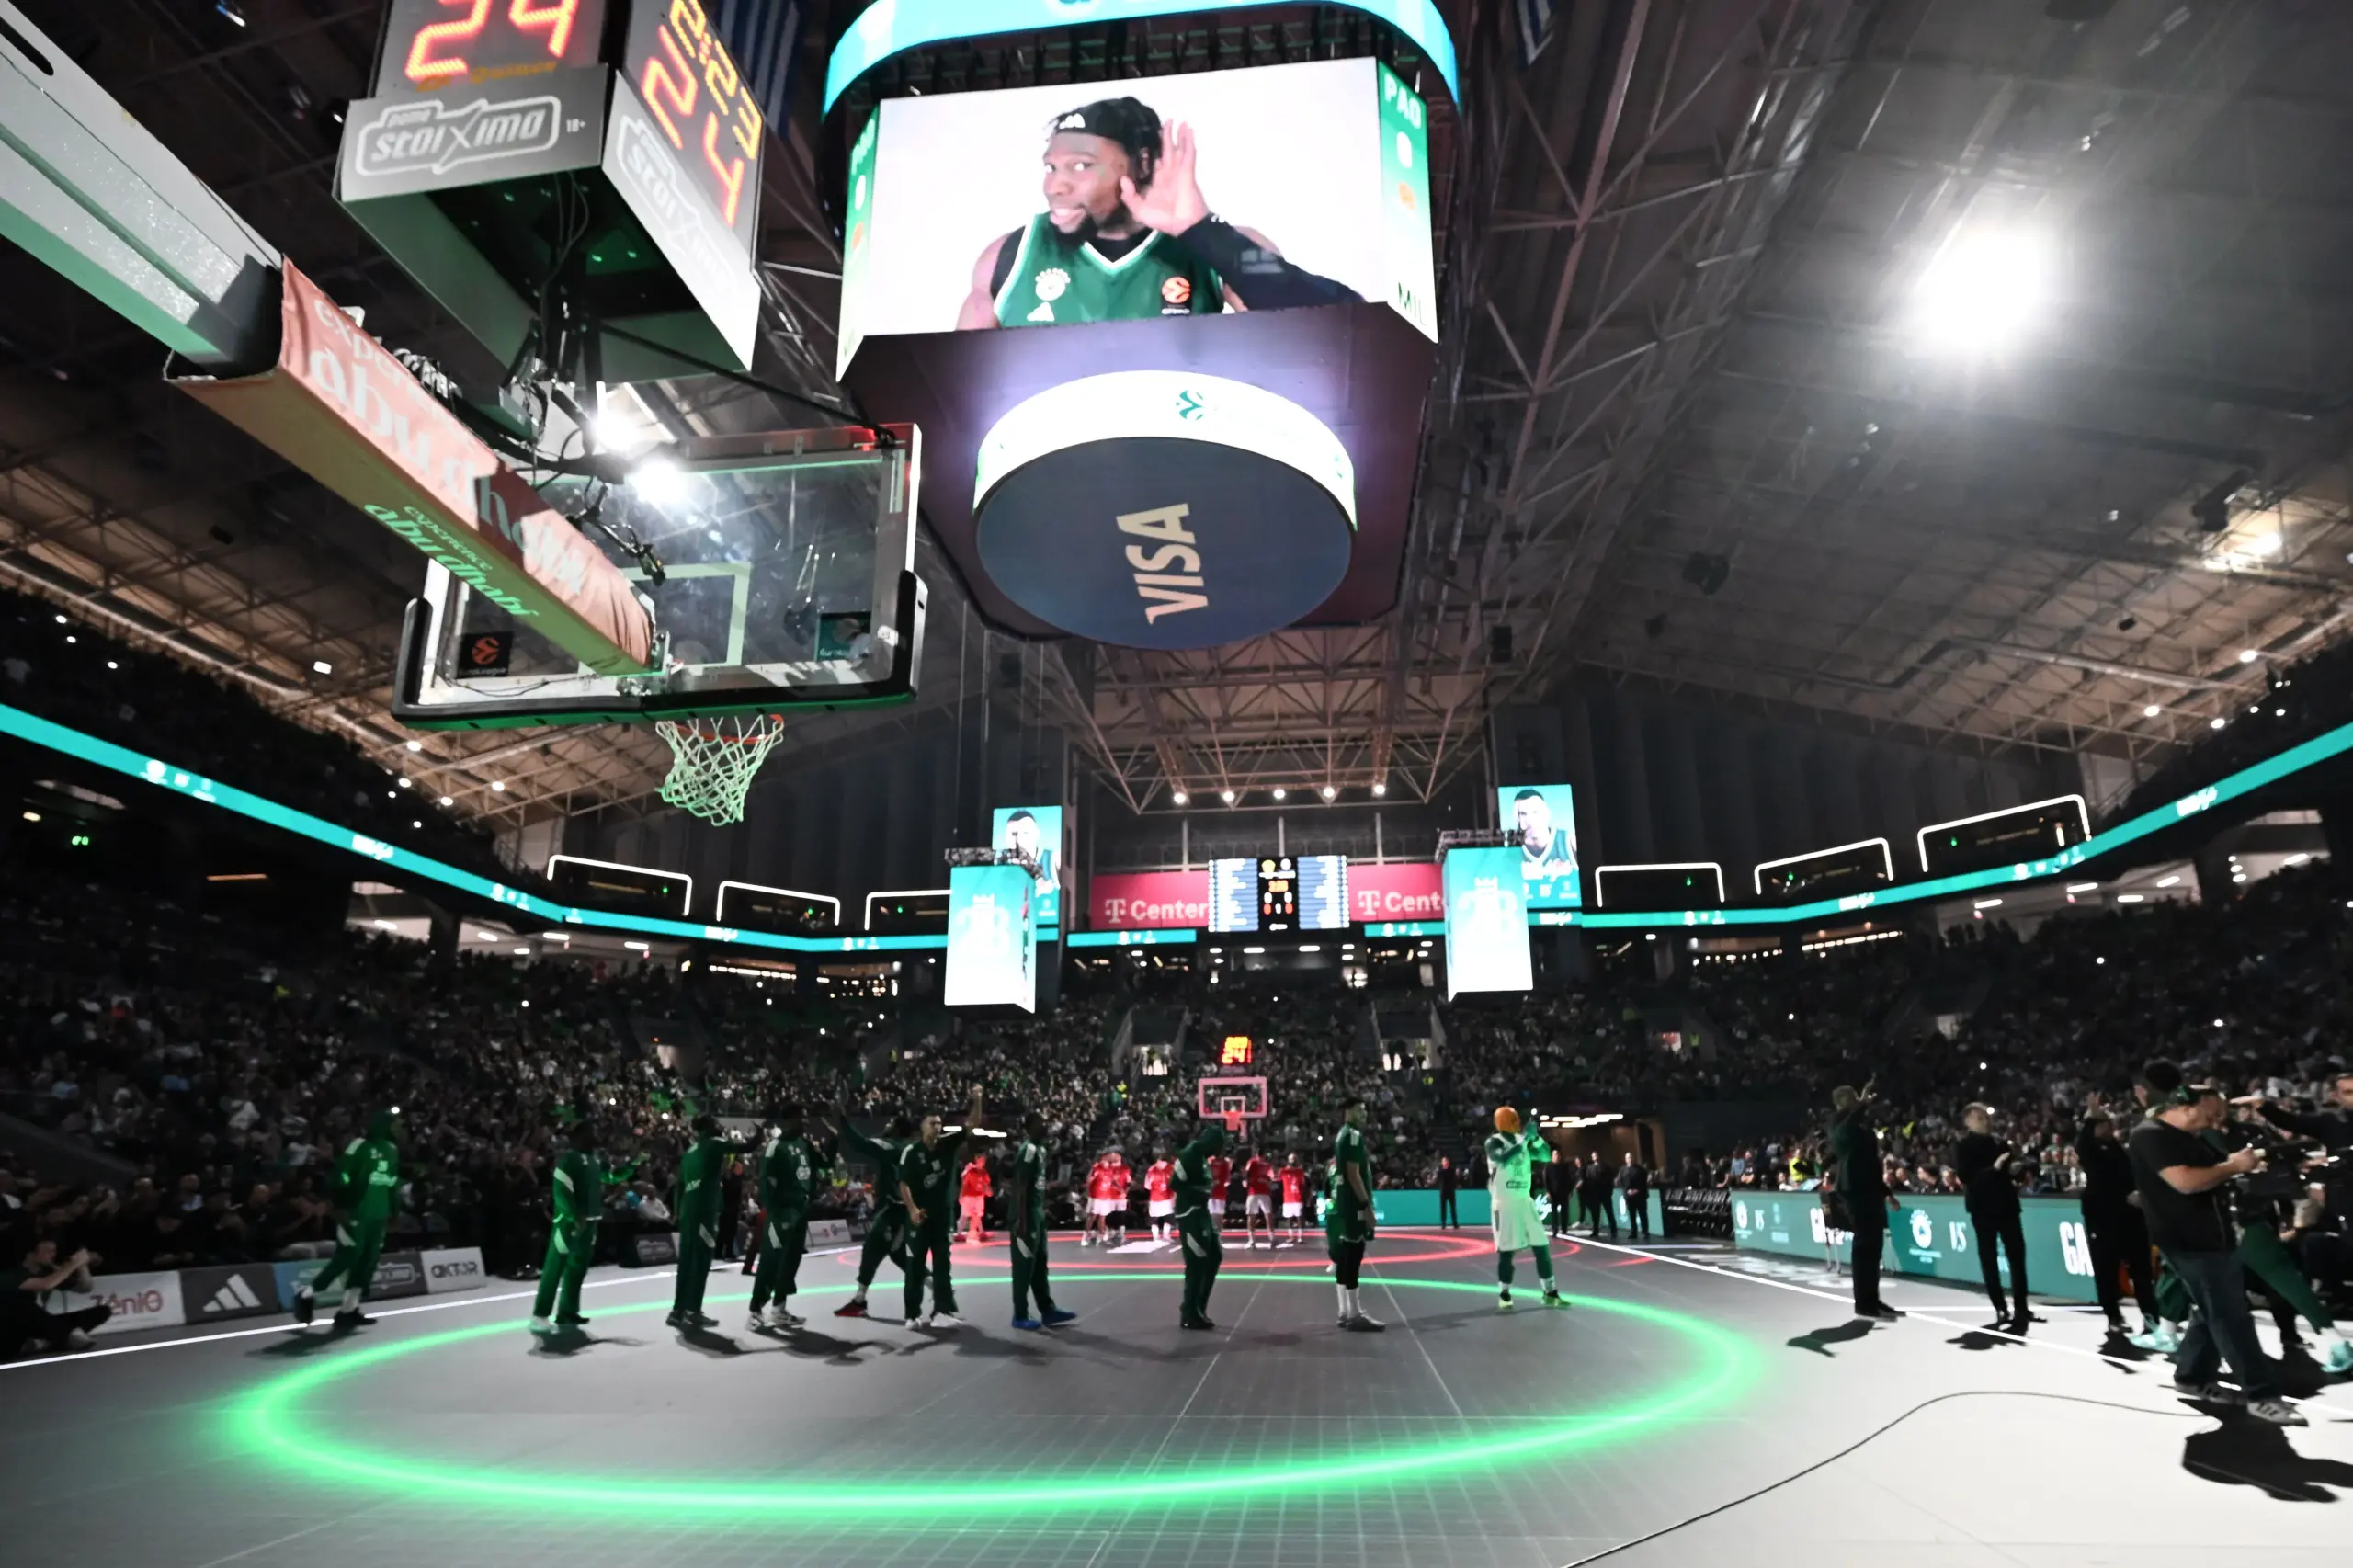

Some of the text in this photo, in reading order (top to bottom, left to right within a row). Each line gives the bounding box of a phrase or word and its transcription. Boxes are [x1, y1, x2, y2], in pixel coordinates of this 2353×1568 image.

[642, 25, 745, 227] 24
[1384, 73, 1421, 129] PAO
[309, 347, 432, 476] abu
[1116, 503, 1209, 626] VISA
[1131, 899, 1209, 921] Center
